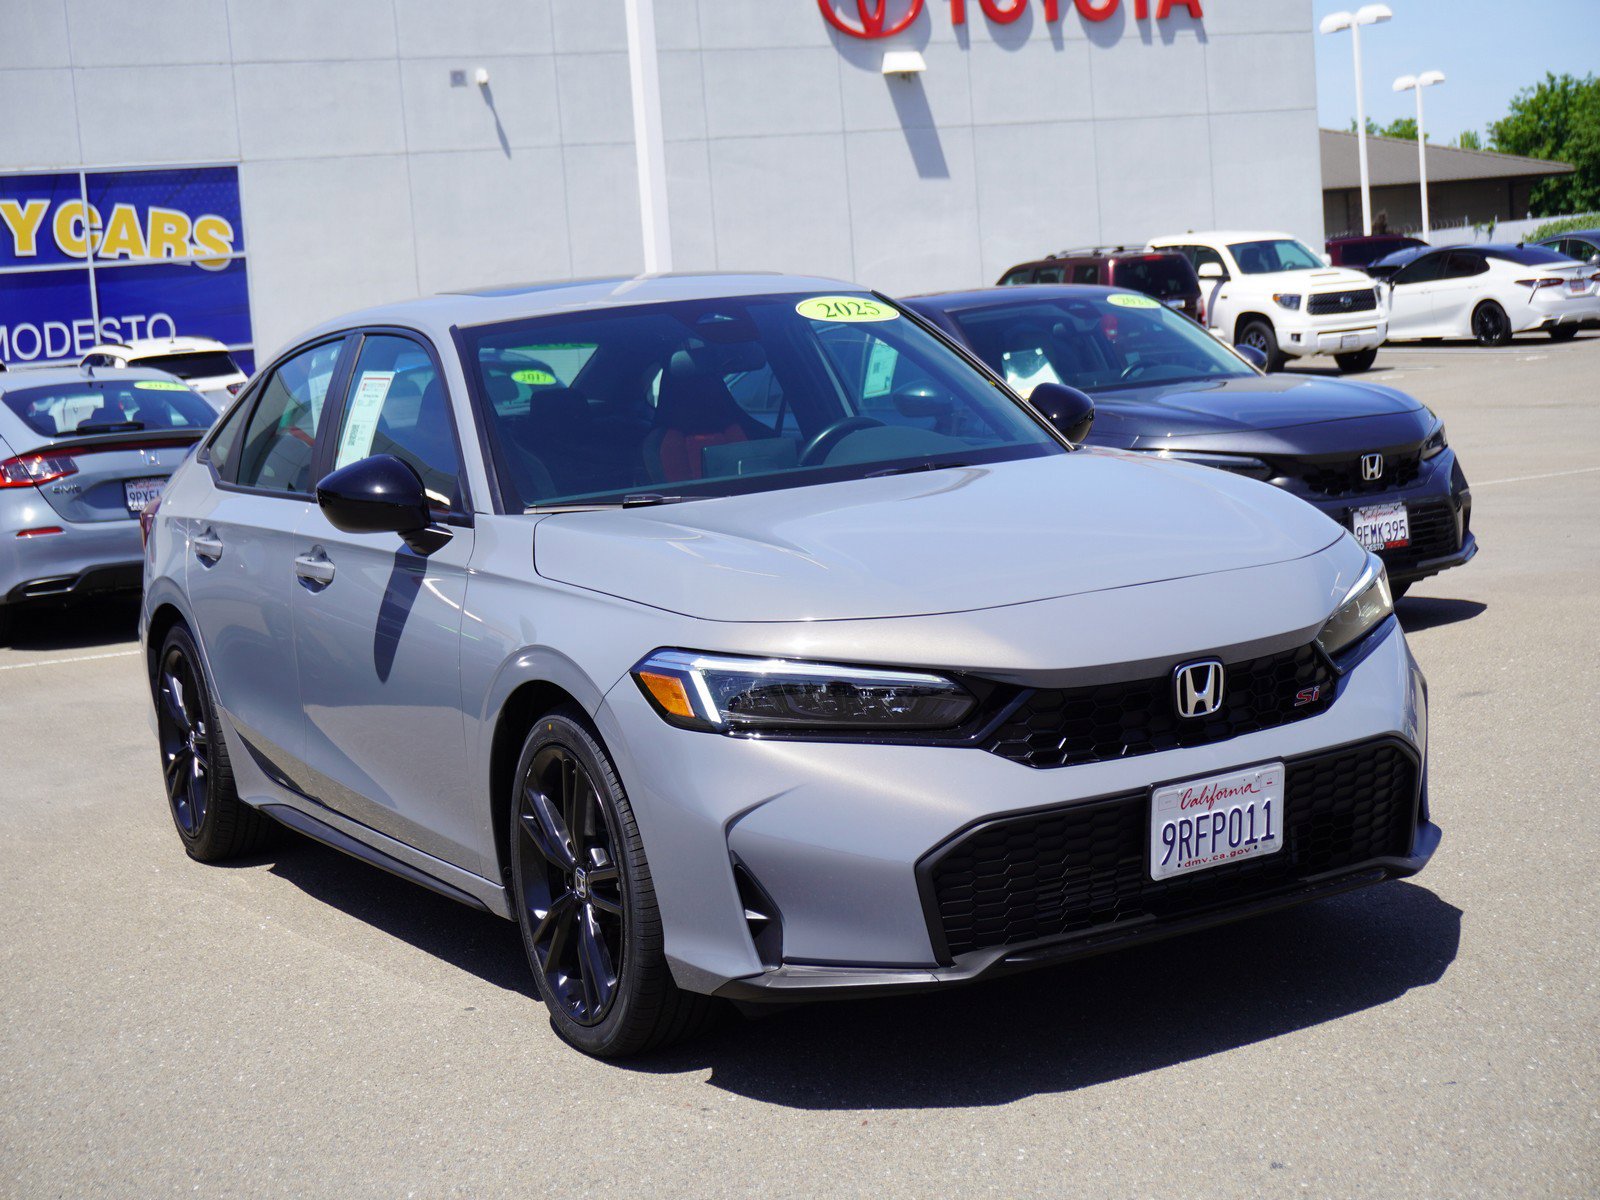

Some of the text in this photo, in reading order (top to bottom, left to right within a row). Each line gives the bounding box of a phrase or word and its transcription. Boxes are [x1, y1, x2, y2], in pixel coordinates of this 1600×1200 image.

[816, 301, 881, 318] 2025
[1294, 685, 1320, 706] Si
[1180, 782, 1261, 811] California
[1161, 799, 1275, 866] 9RFP011
[1184, 847, 1252, 868] dmv.ca.gov
